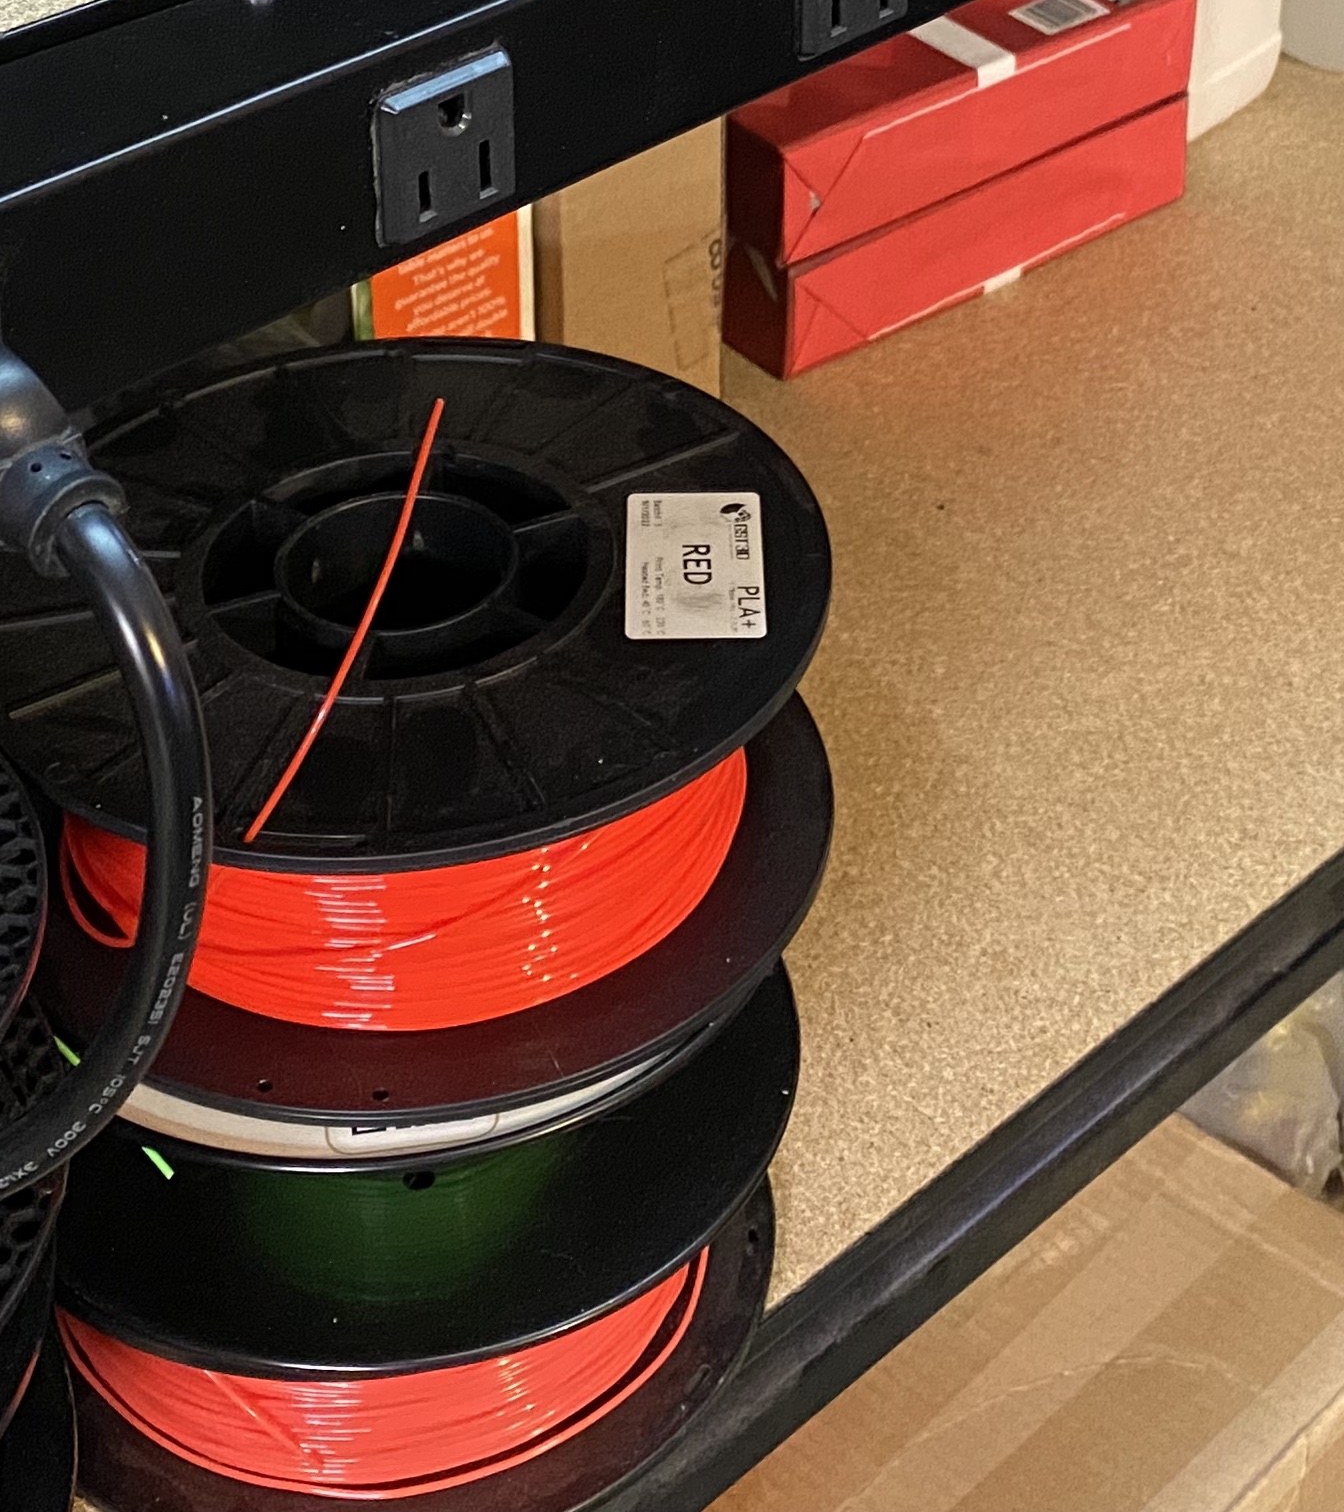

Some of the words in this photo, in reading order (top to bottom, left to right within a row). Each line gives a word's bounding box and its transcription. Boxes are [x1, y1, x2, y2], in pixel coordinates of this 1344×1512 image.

[682, 544, 712, 585] RED
[737, 586, 761, 629] PLA+
[187, 796, 204, 889] AOMENG
[177, 901, 197, 941] (UL)
[146, 952, 185, 1026] E202351
[127, 1034, 152, 1065] SJT
[46, 1120, 87, 1157] 300V
